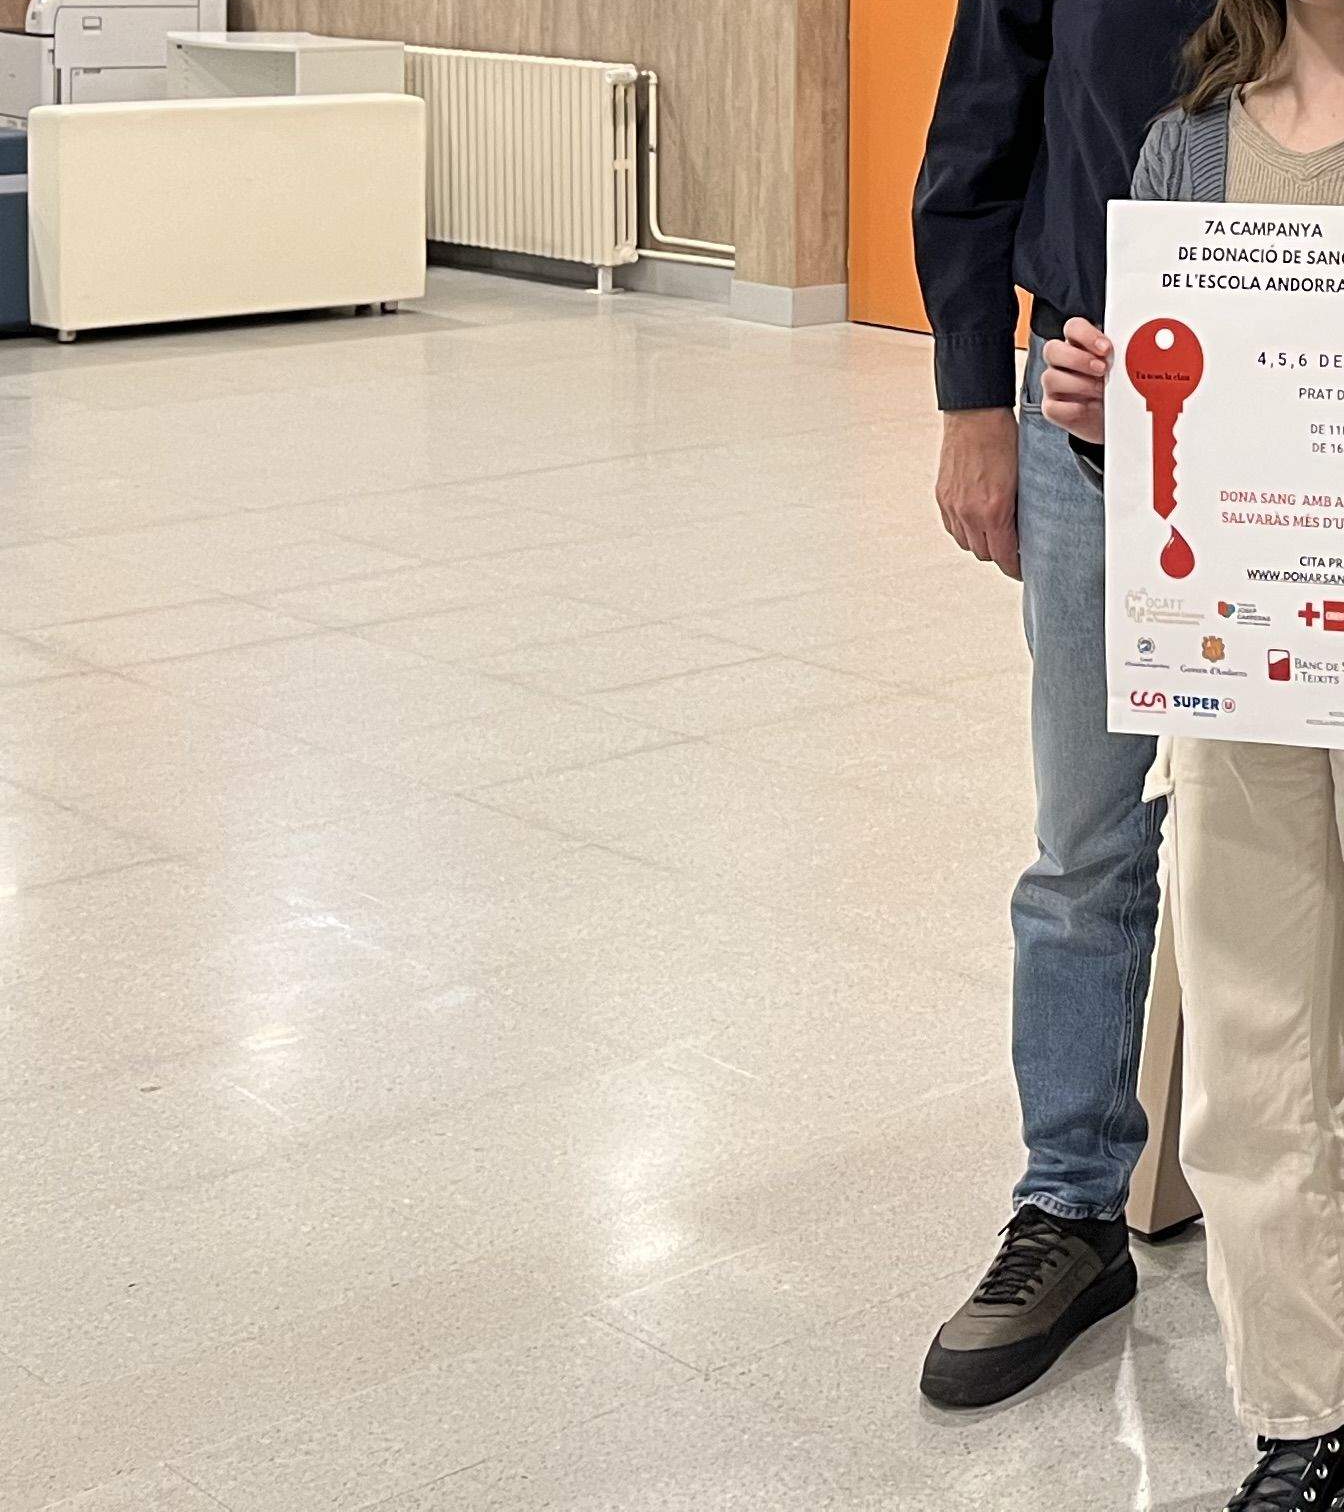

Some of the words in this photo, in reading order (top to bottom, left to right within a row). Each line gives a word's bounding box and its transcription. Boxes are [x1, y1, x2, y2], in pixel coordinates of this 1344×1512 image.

[1204, 220, 1225, 235] 7A
[1230, 222, 1323, 238] CAMPANYA
[1178, 247, 1197, 260] DE
[1202, 245, 1277, 264] DONACIÓ
[1283, 250, 1301, 264] DE
[1162, 274, 1182, 288] DE
[1186, 274, 1261, 291] L'ESCOLA
[1319, 355, 1343, 368] DE
[1299, 388, 1333, 401] PRAT
[1310, 424, 1325, 436] DE
[1312, 443, 1327, 454] DE
[1220, 490, 1256, 504] DONA
[1261, 492, 1296, 506] SANG
[1302, 494, 1332, 507] AMB
[1222, 509, 1289, 527] SALVARÀS
[1293, 511, 1320, 529] MÉS
[1300, 556, 1324, 568] CITA
[1295, 658, 1323, 671] BANC
[1327, 663, 1339, 671] DE
[1301, 671, 1339, 685] TEIXITS
[1174, 695, 1220, 710] SUPER
